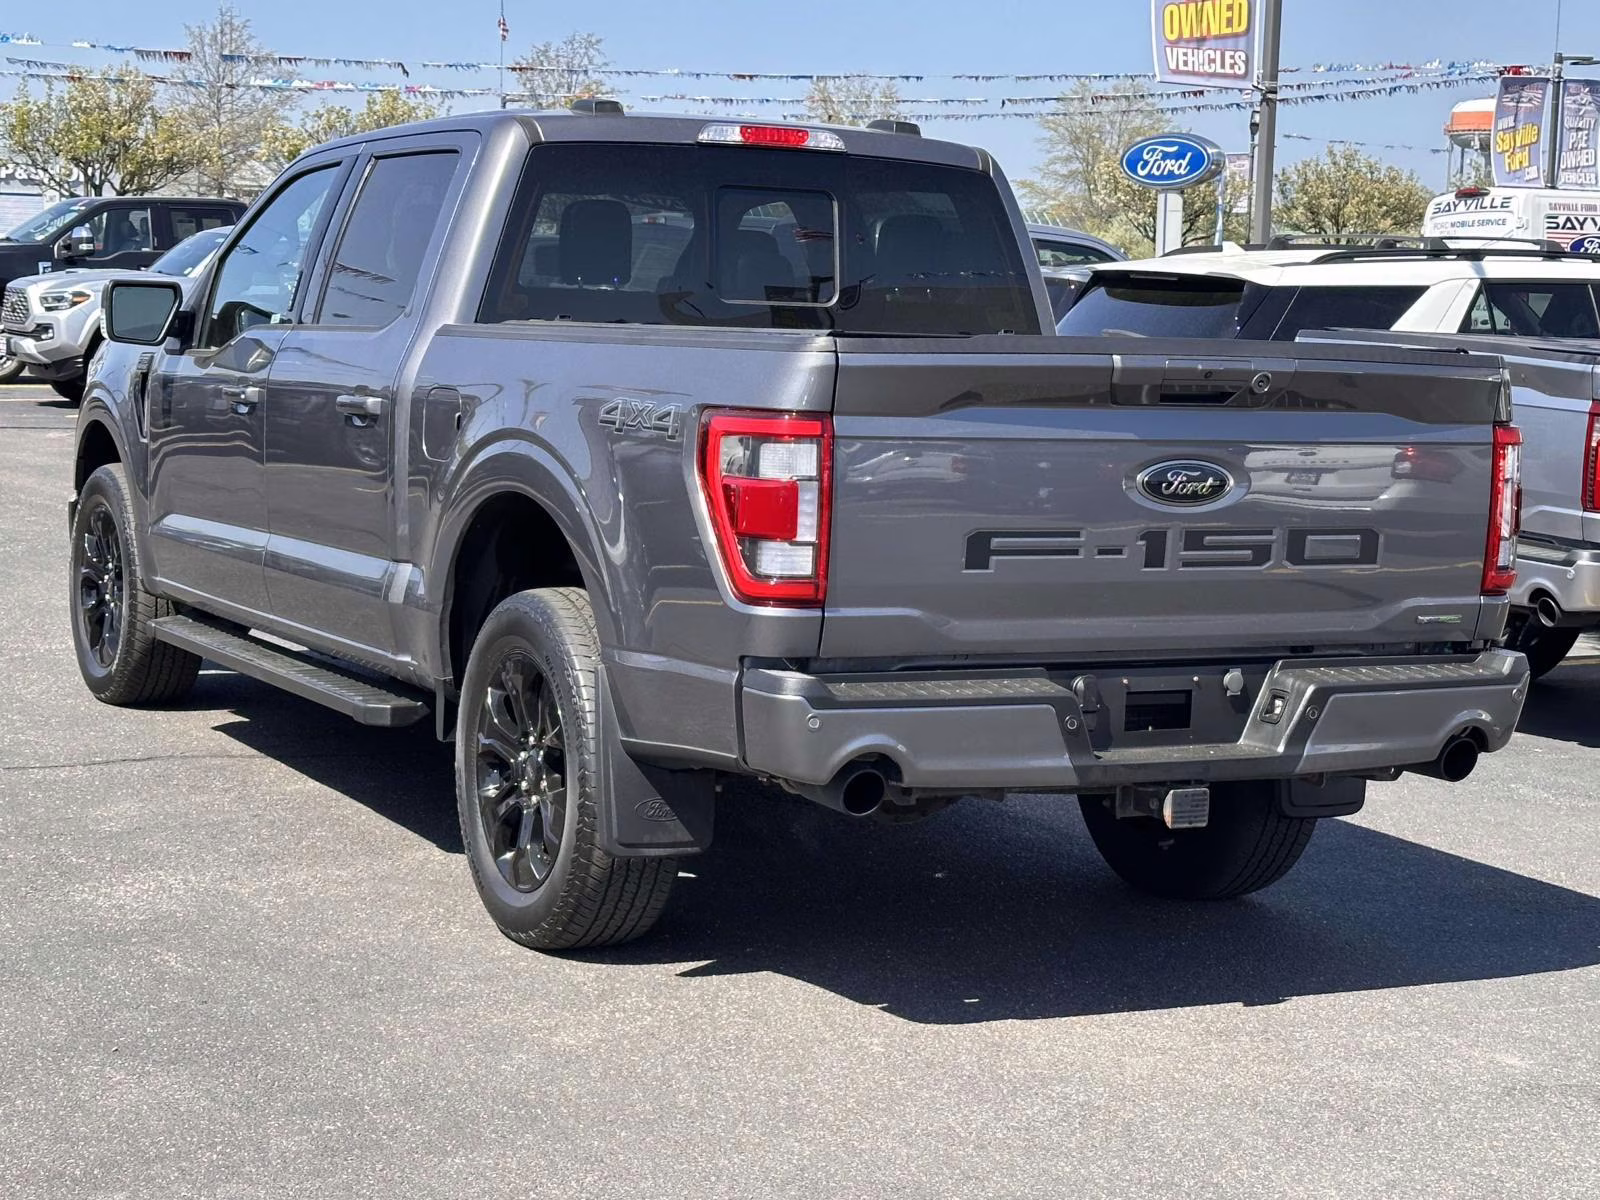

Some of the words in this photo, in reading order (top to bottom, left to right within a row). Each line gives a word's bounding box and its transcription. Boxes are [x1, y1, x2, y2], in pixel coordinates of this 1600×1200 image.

[1164, 0, 1249, 41] OWNED
[1165, 47, 1247, 75] VEHICLES
[1495, 122, 1539, 154] Sayville
[1137, 145, 1193, 176] Ford
[1504, 146, 1530, 173] Ford
[1561, 149, 1595, 169] OWNED
[1432, 197, 1513, 215] SAYVILLE
[1548, 202, 1579, 212] SAYVILLE
[1450, 220, 1476, 229] MOBILE
[1476, 218, 1507, 227] SERVICE
[598, 397, 682, 441] 4X4
[1162, 469, 1214, 495] Ford
[961, 526, 1383, 574] F-150
